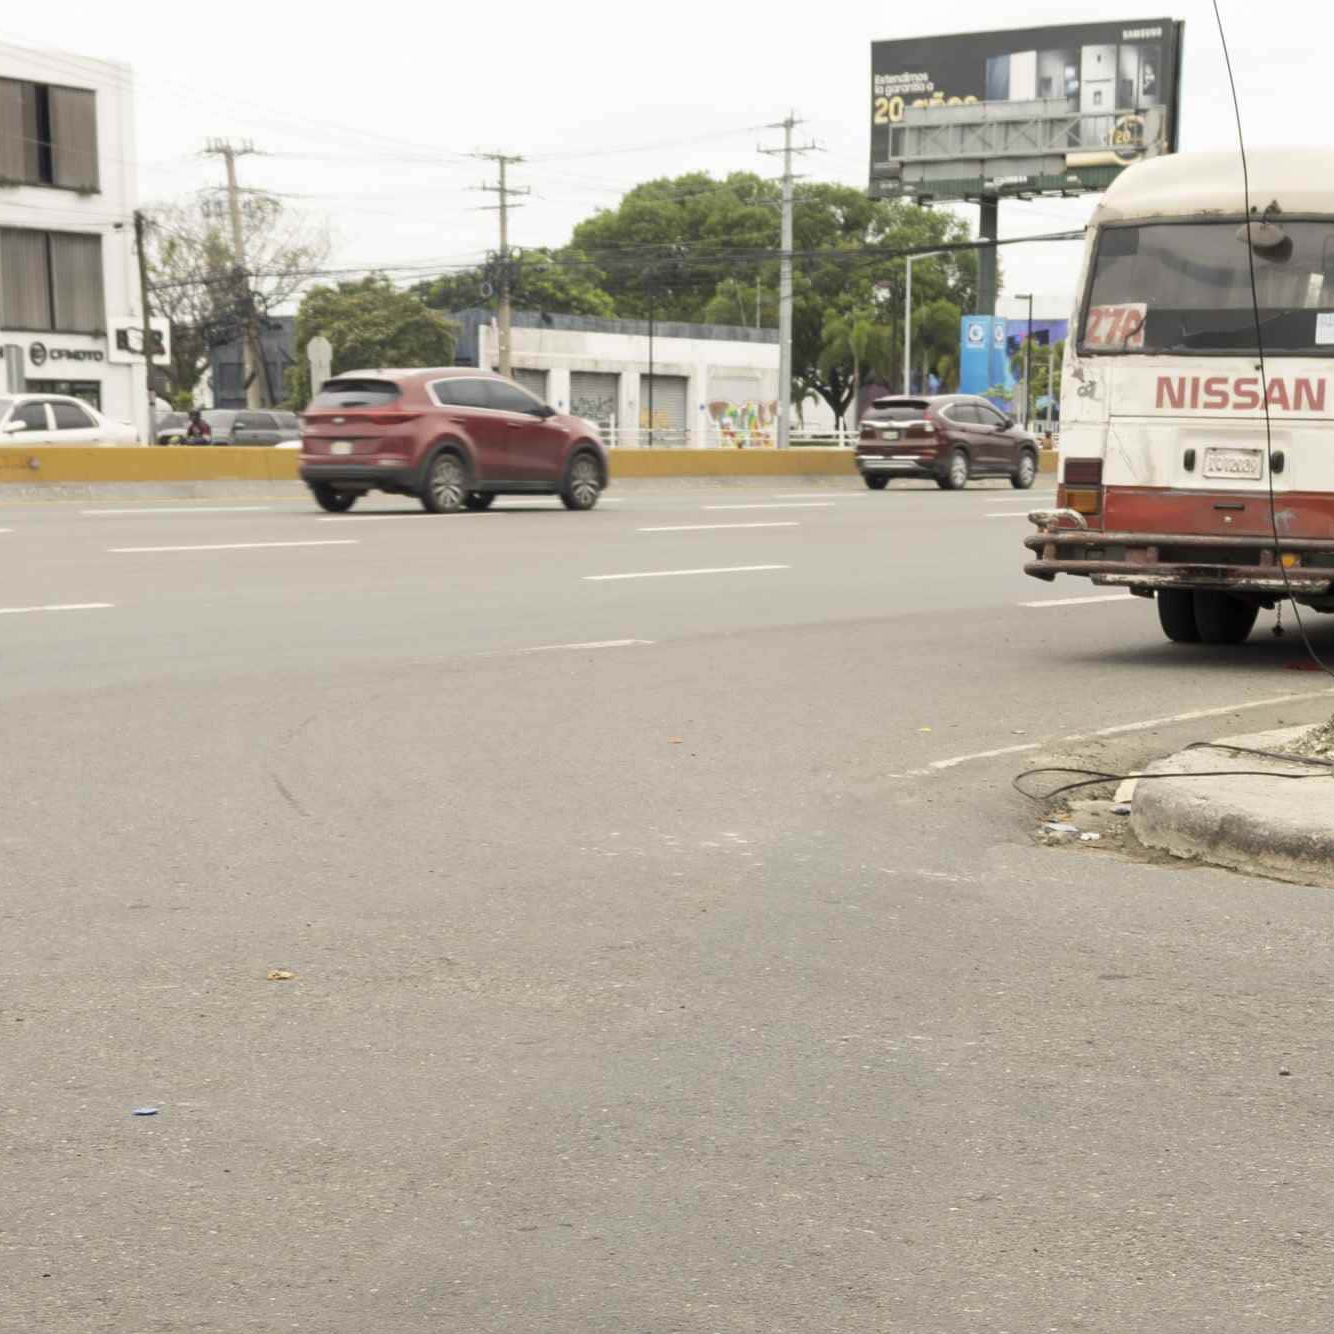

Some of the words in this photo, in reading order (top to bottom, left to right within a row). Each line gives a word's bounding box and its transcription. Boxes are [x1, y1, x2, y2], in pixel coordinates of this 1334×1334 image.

[1123, 27, 1162, 40] SAMSUNG
[874, 96, 905, 124] 20
[1155, 376, 1326, 411] NISSAN
